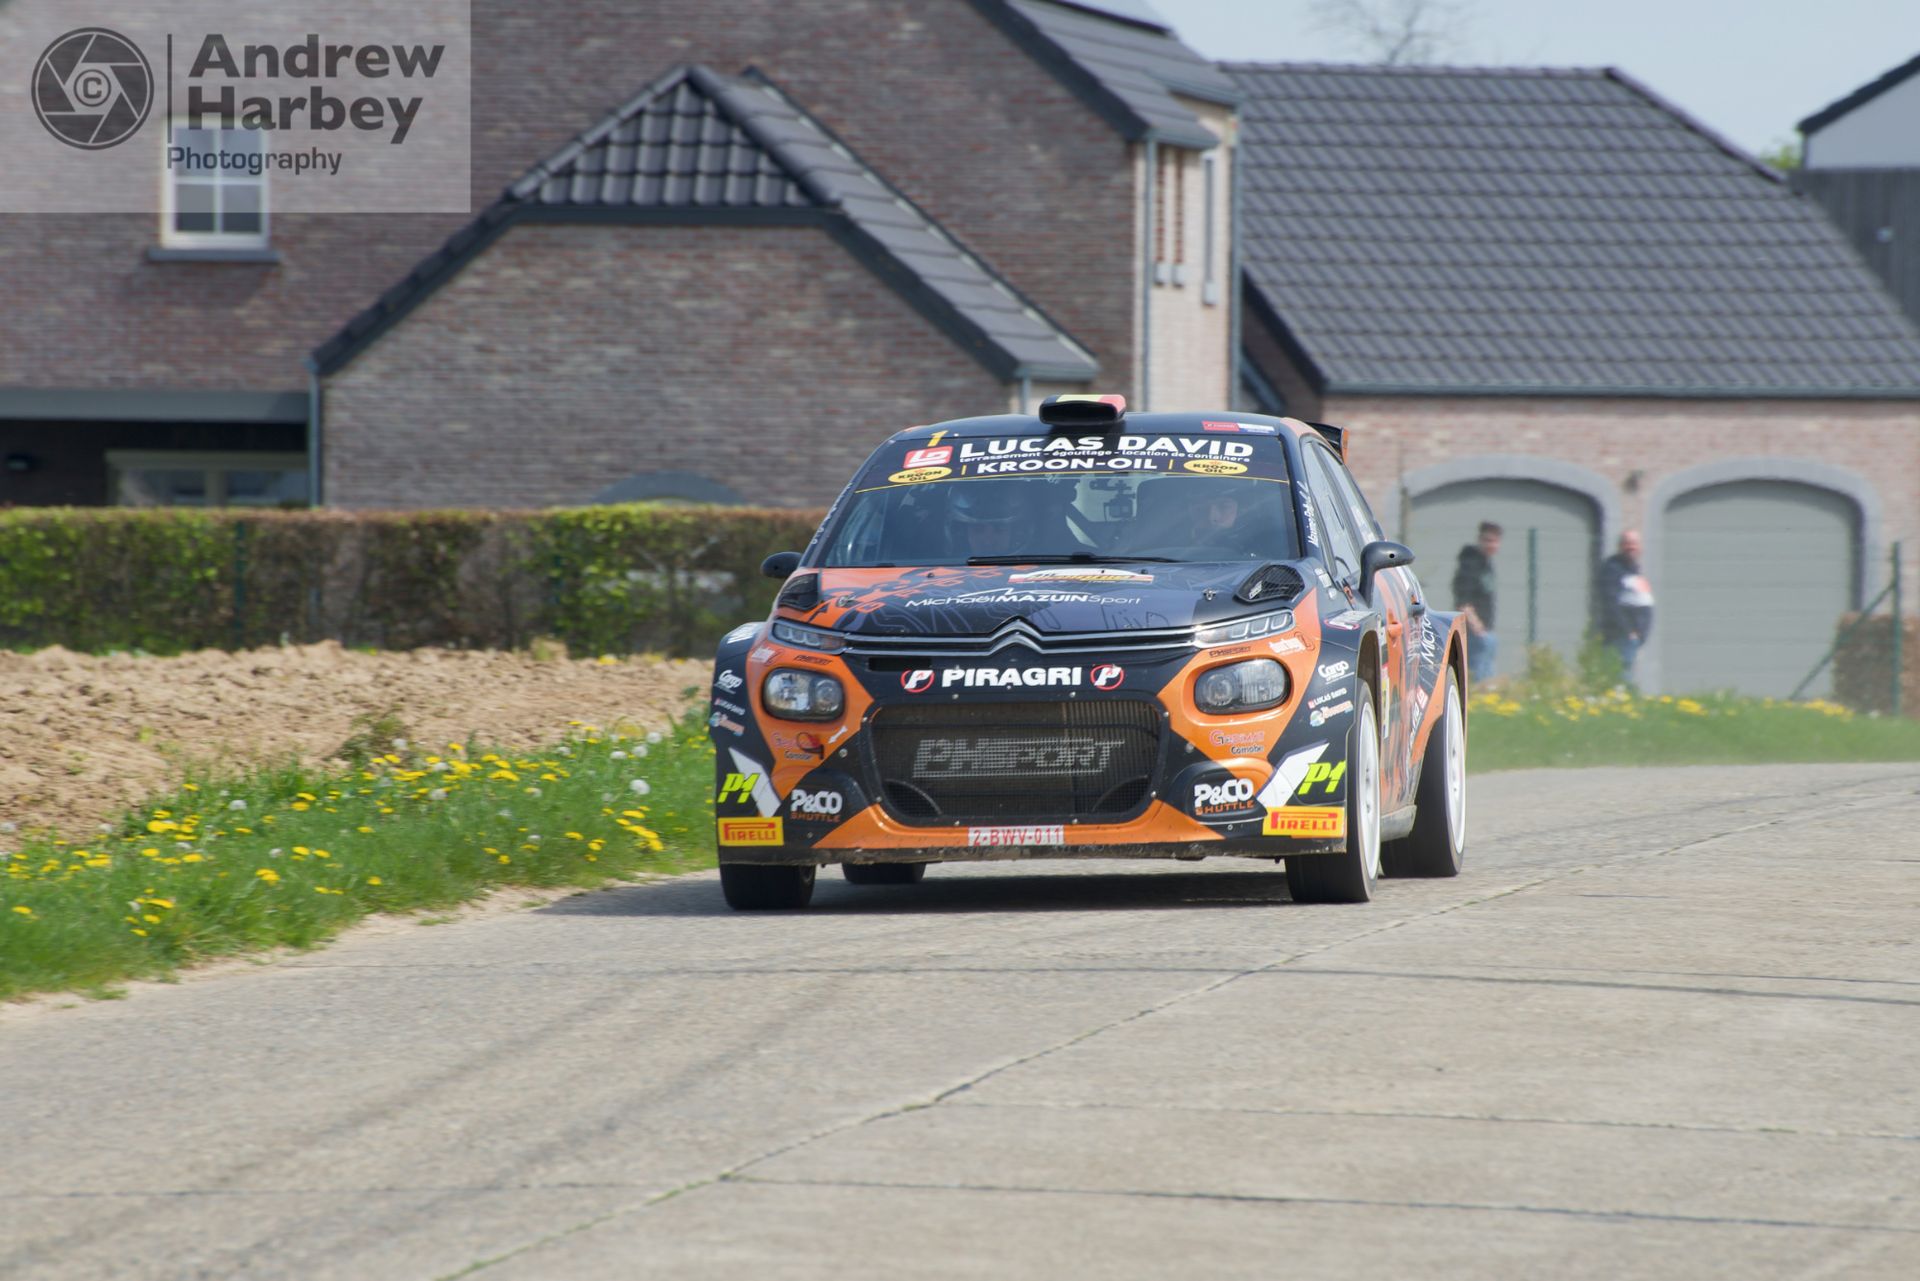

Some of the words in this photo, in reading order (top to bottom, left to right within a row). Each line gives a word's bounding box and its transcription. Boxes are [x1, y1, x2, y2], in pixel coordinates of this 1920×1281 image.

[959, 451, 1041, 463] terrassement
[1053, 448, 1112, 458] égouttage
[1122, 449, 1169, 458] location
[1171, 451, 1186, 459] de
[1187, 452, 1250, 463] containers
[960, 435, 1104, 459] LUCAS
[1118, 436, 1253, 458] DAVID
[898, 469, 943, 480] KROON
[977, 458, 1158, 474] KROON-OIL
[1192, 463, 1239, 471] KROON
[941, 666, 1083, 687] PIRAGRI
[1318, 660, 1350, 679] Cargo
[1298, 760, 1346, 795] P1
[717, 773, 760, 804] P1
[1194, 777, 1254, 808] P&CO
[790, 789, 843, 815] P&CO
[1195, 800, 1255, 816] SHUTTLE
[791, 812, 841, 823] SHUTTLE
[1270, 811, 1338, 830] PIRELLI
[723, 822, 776, 841] PIRELLI
[973, 827, 1060, 847] 2-BWV-011
